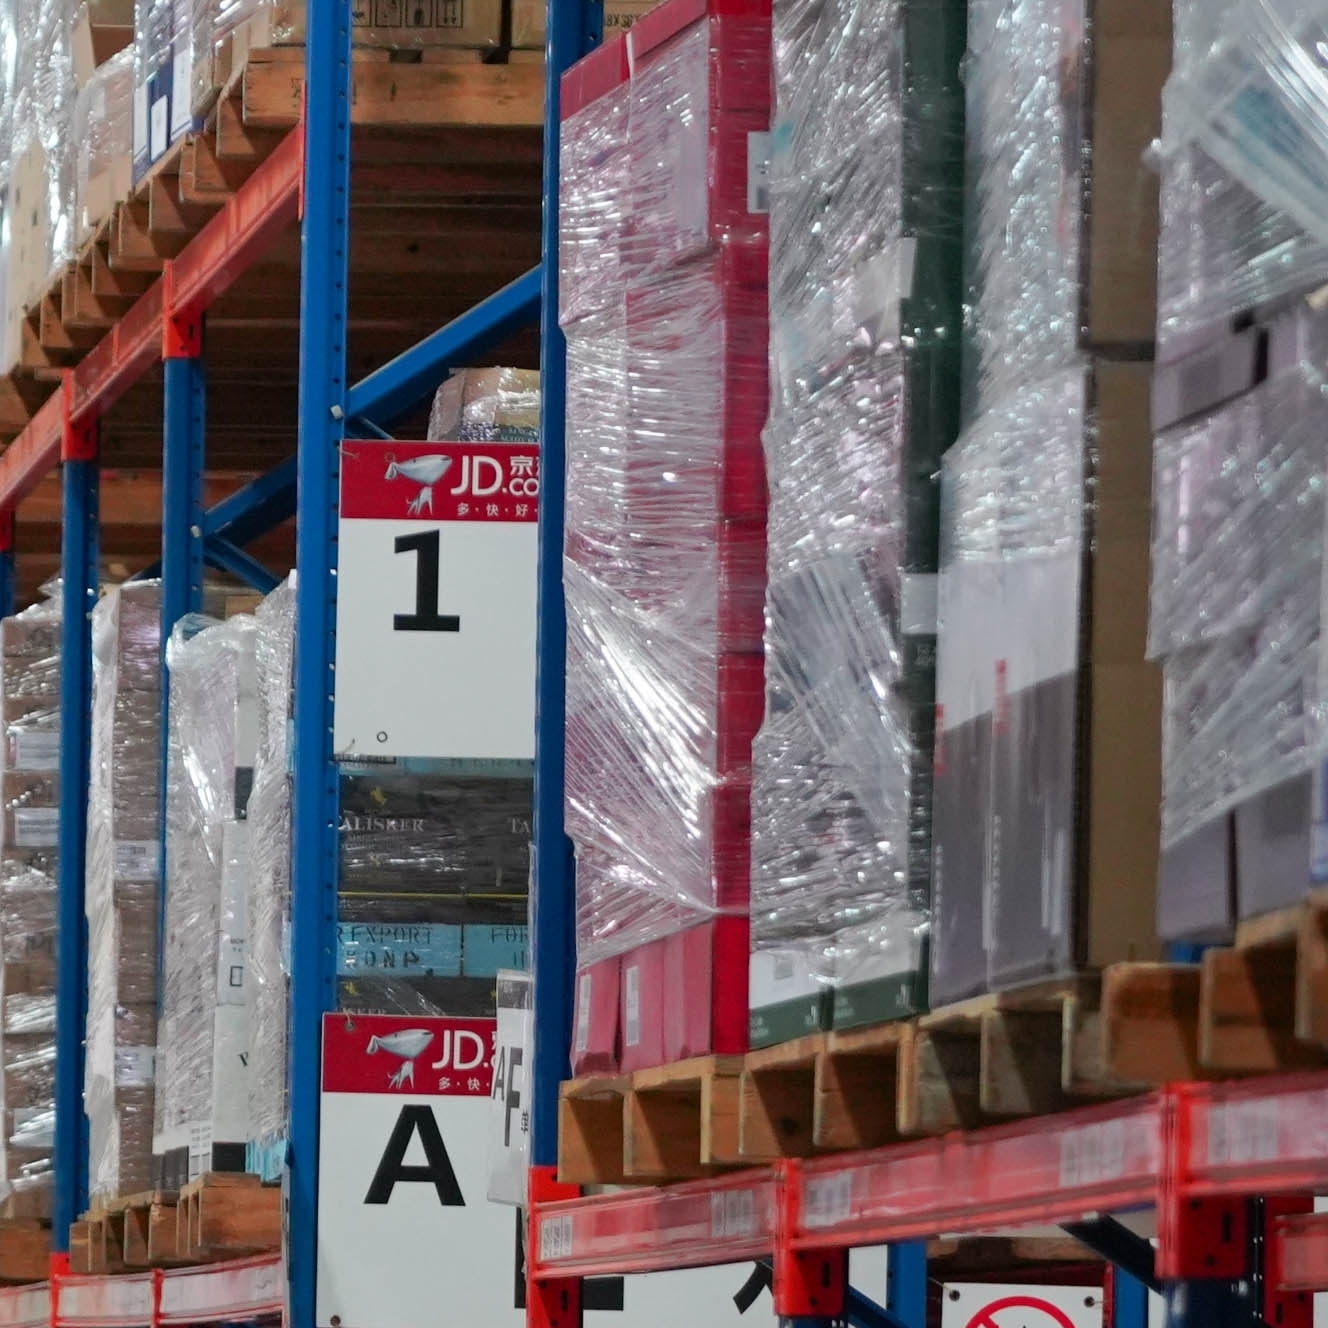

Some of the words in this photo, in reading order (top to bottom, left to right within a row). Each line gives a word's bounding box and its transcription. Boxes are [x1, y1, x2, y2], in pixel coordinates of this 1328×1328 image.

[450, 455, 539, 496] JD.CO
[510, 455, 539, 476] 京
[394, 528, 460, 632] 1
[338, 818, 424, 832] ALISKER
[432, 1030, 495, 1070] JD.
[363, 1104, 466, 1207] A
